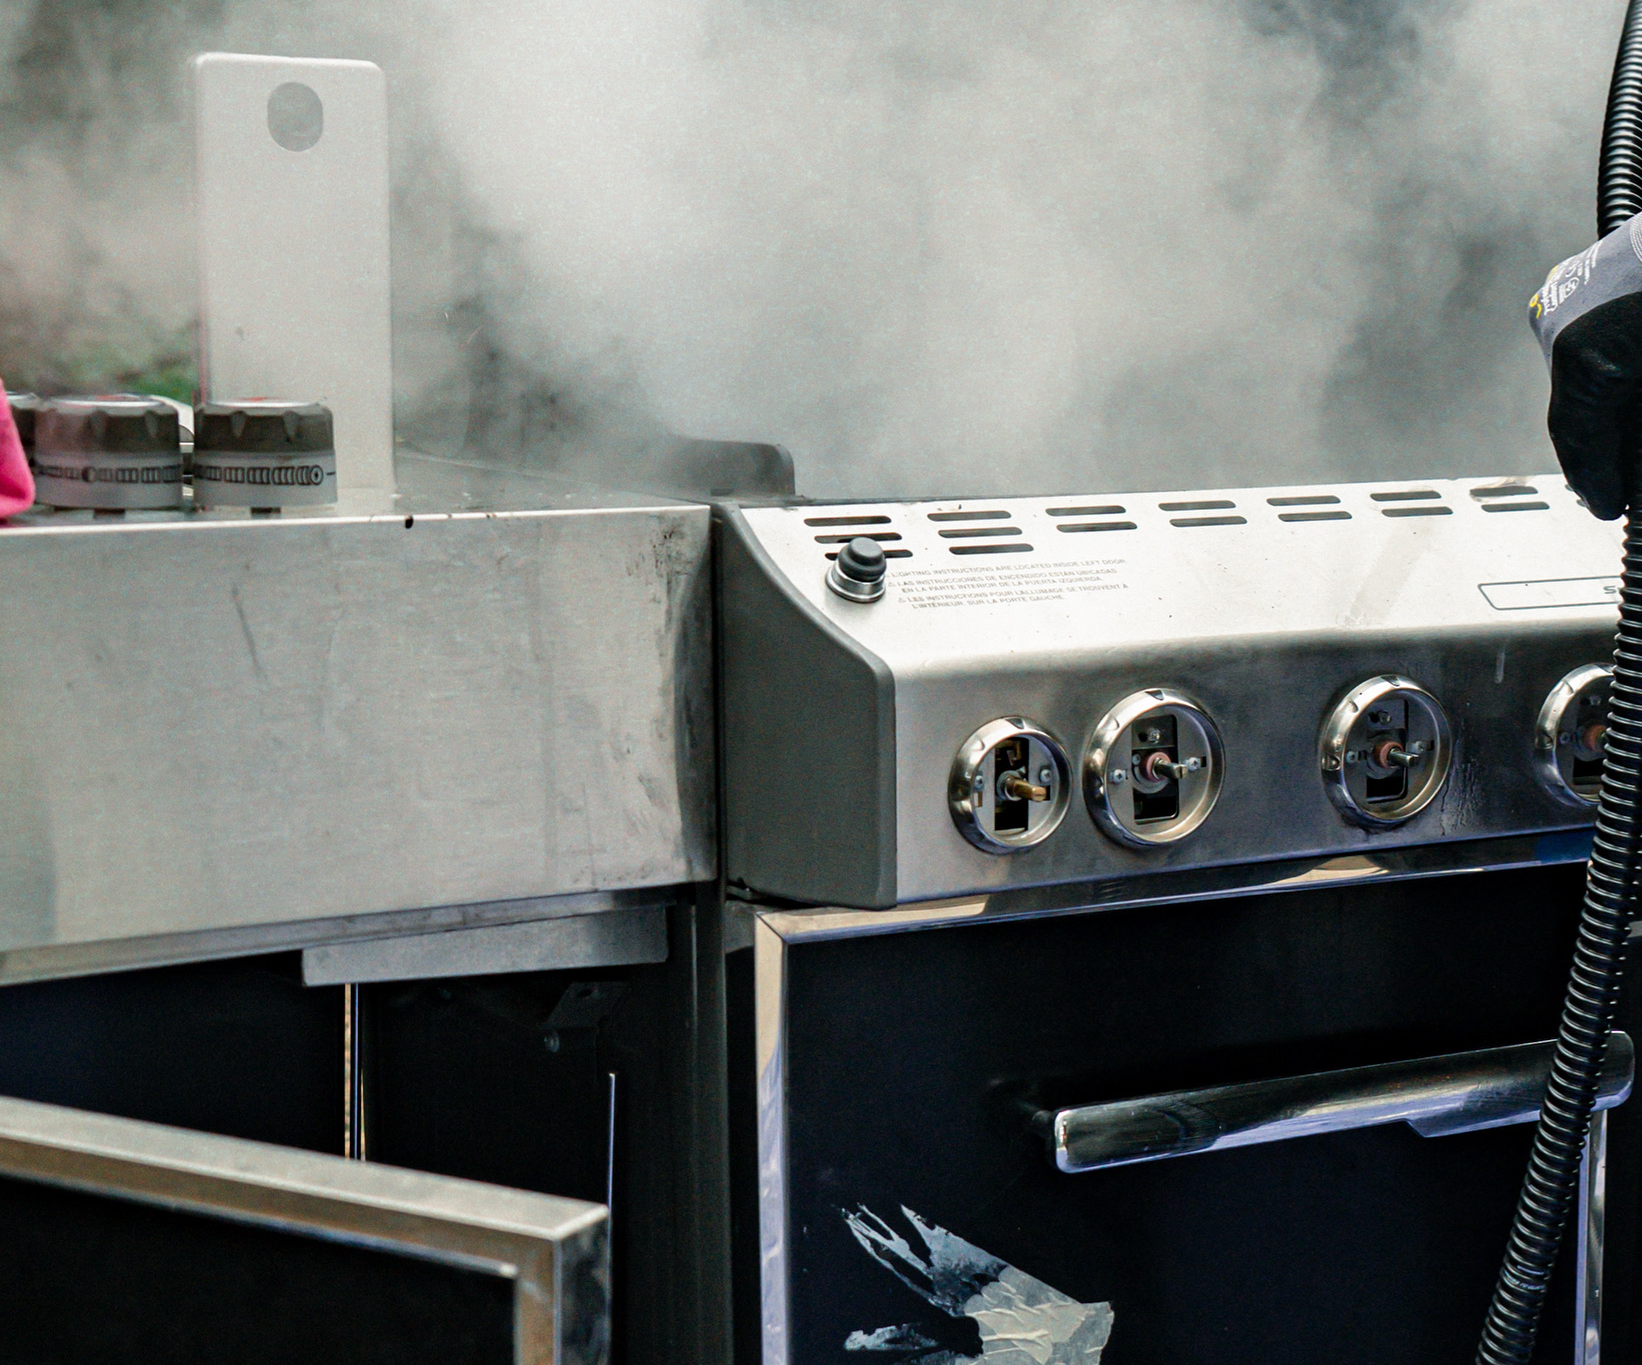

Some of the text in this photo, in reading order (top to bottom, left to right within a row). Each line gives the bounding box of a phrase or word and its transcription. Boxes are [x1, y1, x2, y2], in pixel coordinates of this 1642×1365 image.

[891, 569, 931, 577] LIGHTING
[932, 567, 994, 575] INSTRUCTIONS
[1014, 562, 1052, 570] LOCATED
[916, 575, 984, 585] INSTRUCCIONES
[998, 572, 1048, 581] ENCENDIDO
[958, 581, 997, 589] INTERIOR
[1025, 577, 1057, 585] PUERTA
[926, 593, 988, 601] INSTRUCTIONS
[1078, 583, 1122, 591] TROUVENT
